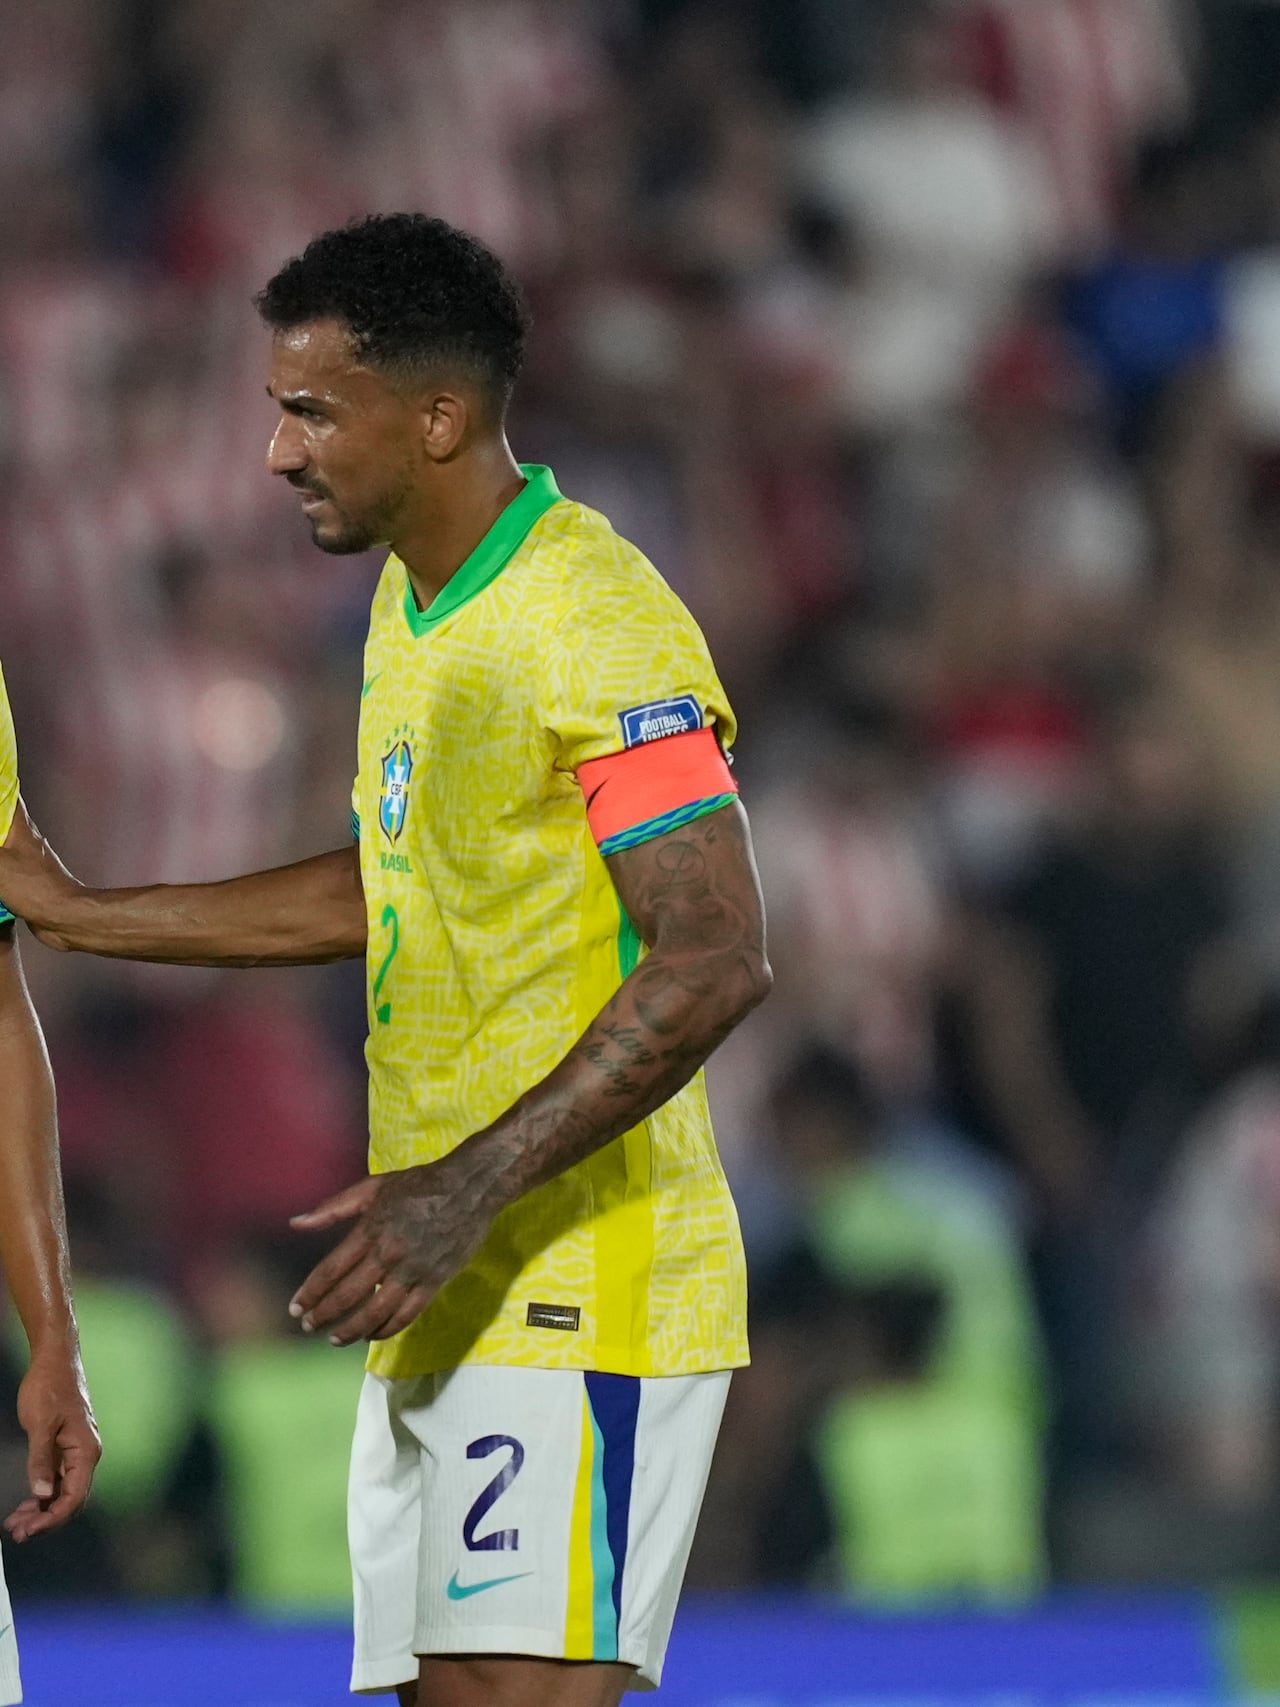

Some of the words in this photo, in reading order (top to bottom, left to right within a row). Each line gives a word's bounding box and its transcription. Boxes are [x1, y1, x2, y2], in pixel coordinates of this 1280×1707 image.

[639, 712, 688, 735] FOOTBALL
[373, 903, 399, 1024] 2
[463, 1434, 525, 1552] 2
